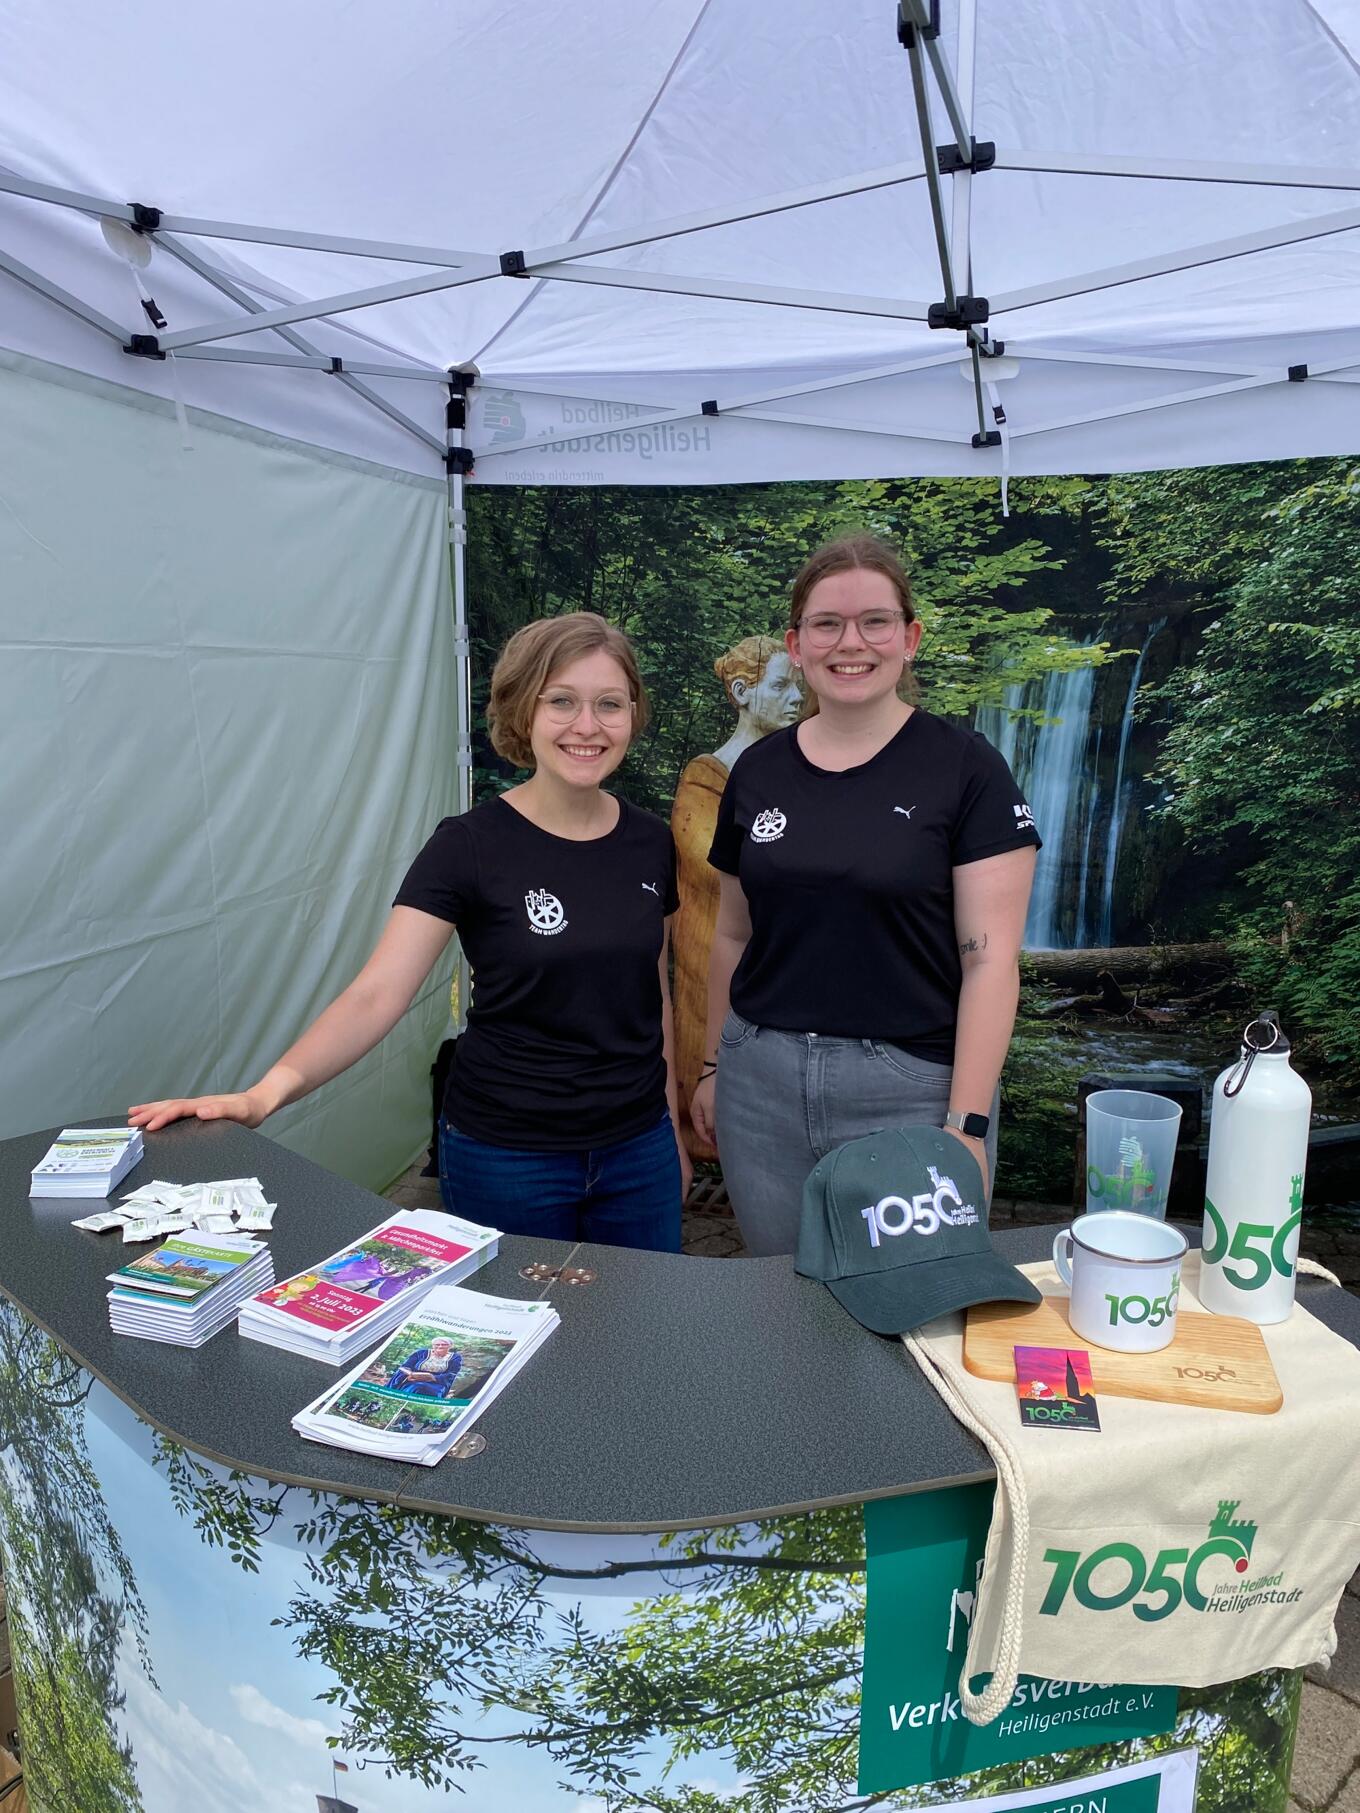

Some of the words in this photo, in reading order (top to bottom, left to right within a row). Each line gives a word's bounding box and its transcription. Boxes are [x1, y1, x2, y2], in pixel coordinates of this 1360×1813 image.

[861, 1186, 963, 1248] 1050
[317, 1296, 341, 1308] Juli
[1172, 1366, 1236, 1382] 1050
[1025, 1407, 1076, 1423] 1050
[1039, 1536, 1250, 1623] 1050
[1212, 1581, 1239, 1597] Jahre
[1239, 1571, 1284, 1593] Heilbad
[1205, 1587, 1304, 1614] Heiligenstadt
[998, 1697, 1121, 1738] Heiligenstadt
[1125, 1692, 1155, 1713] e.V.
